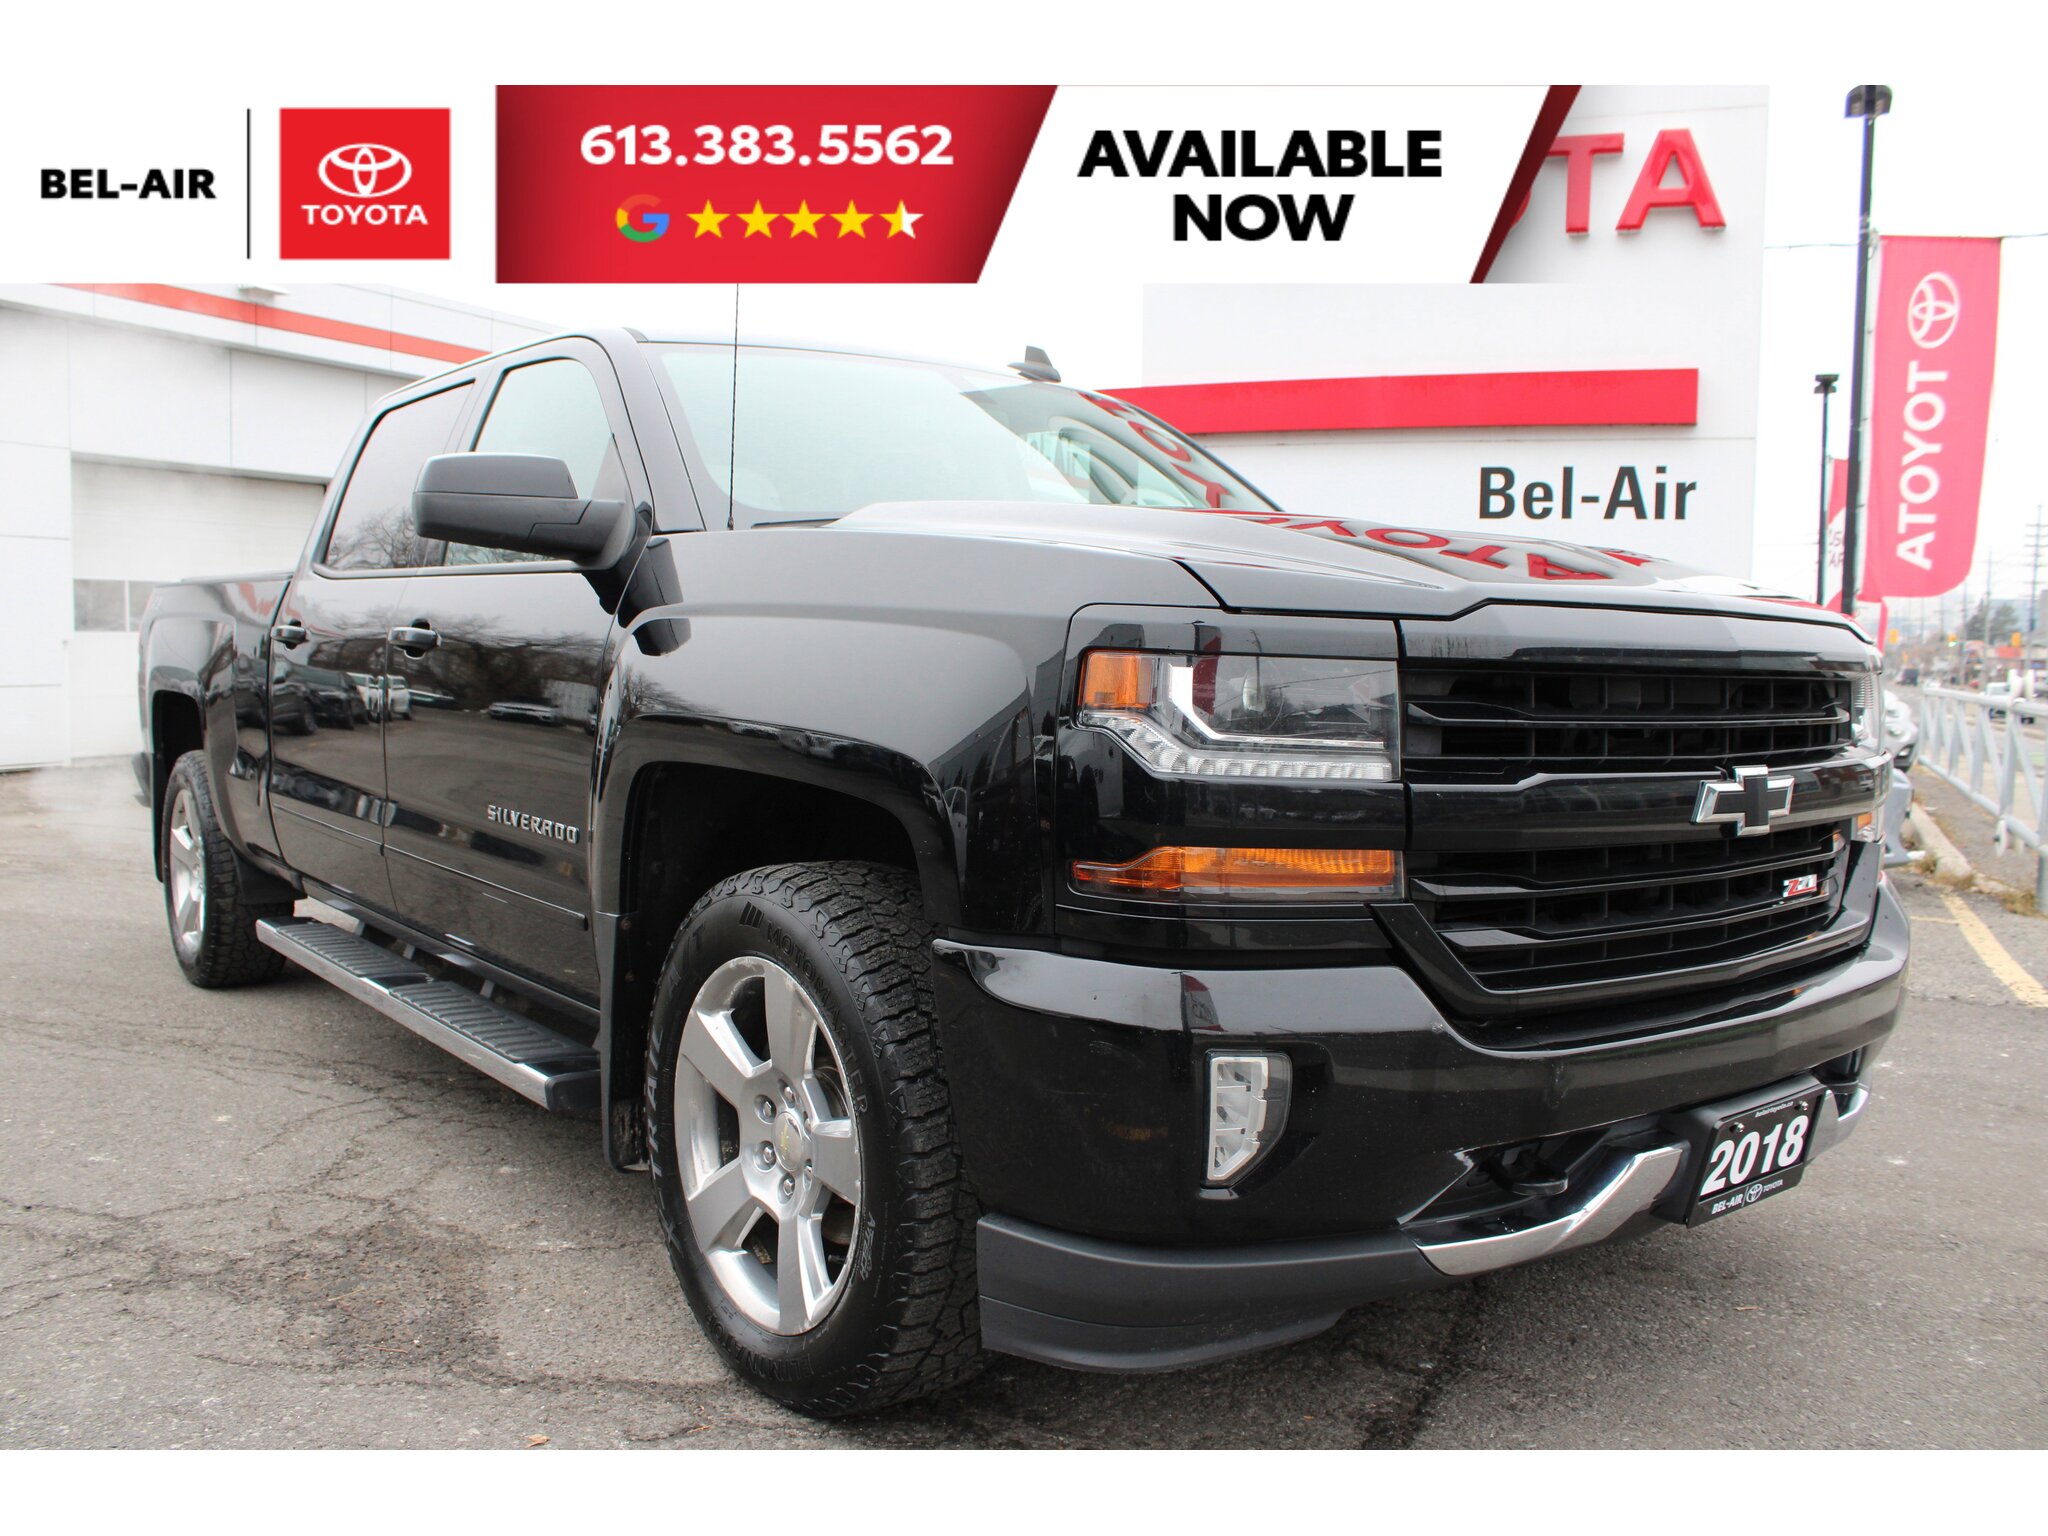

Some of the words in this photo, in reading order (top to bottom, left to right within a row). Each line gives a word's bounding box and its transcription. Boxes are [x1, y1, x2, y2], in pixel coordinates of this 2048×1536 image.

[1508, 129, 1726, 234] TA
[1479, 466, 1696, 520] Bel-Air
[487, 804, 580, 845] SILVERADO
[1700, 1115, 1809, 1196] 2018
[1711, 1193, 1744, 1214] BEL-AIR
[1762, 1179, 1784, 1193] TOYOTA
